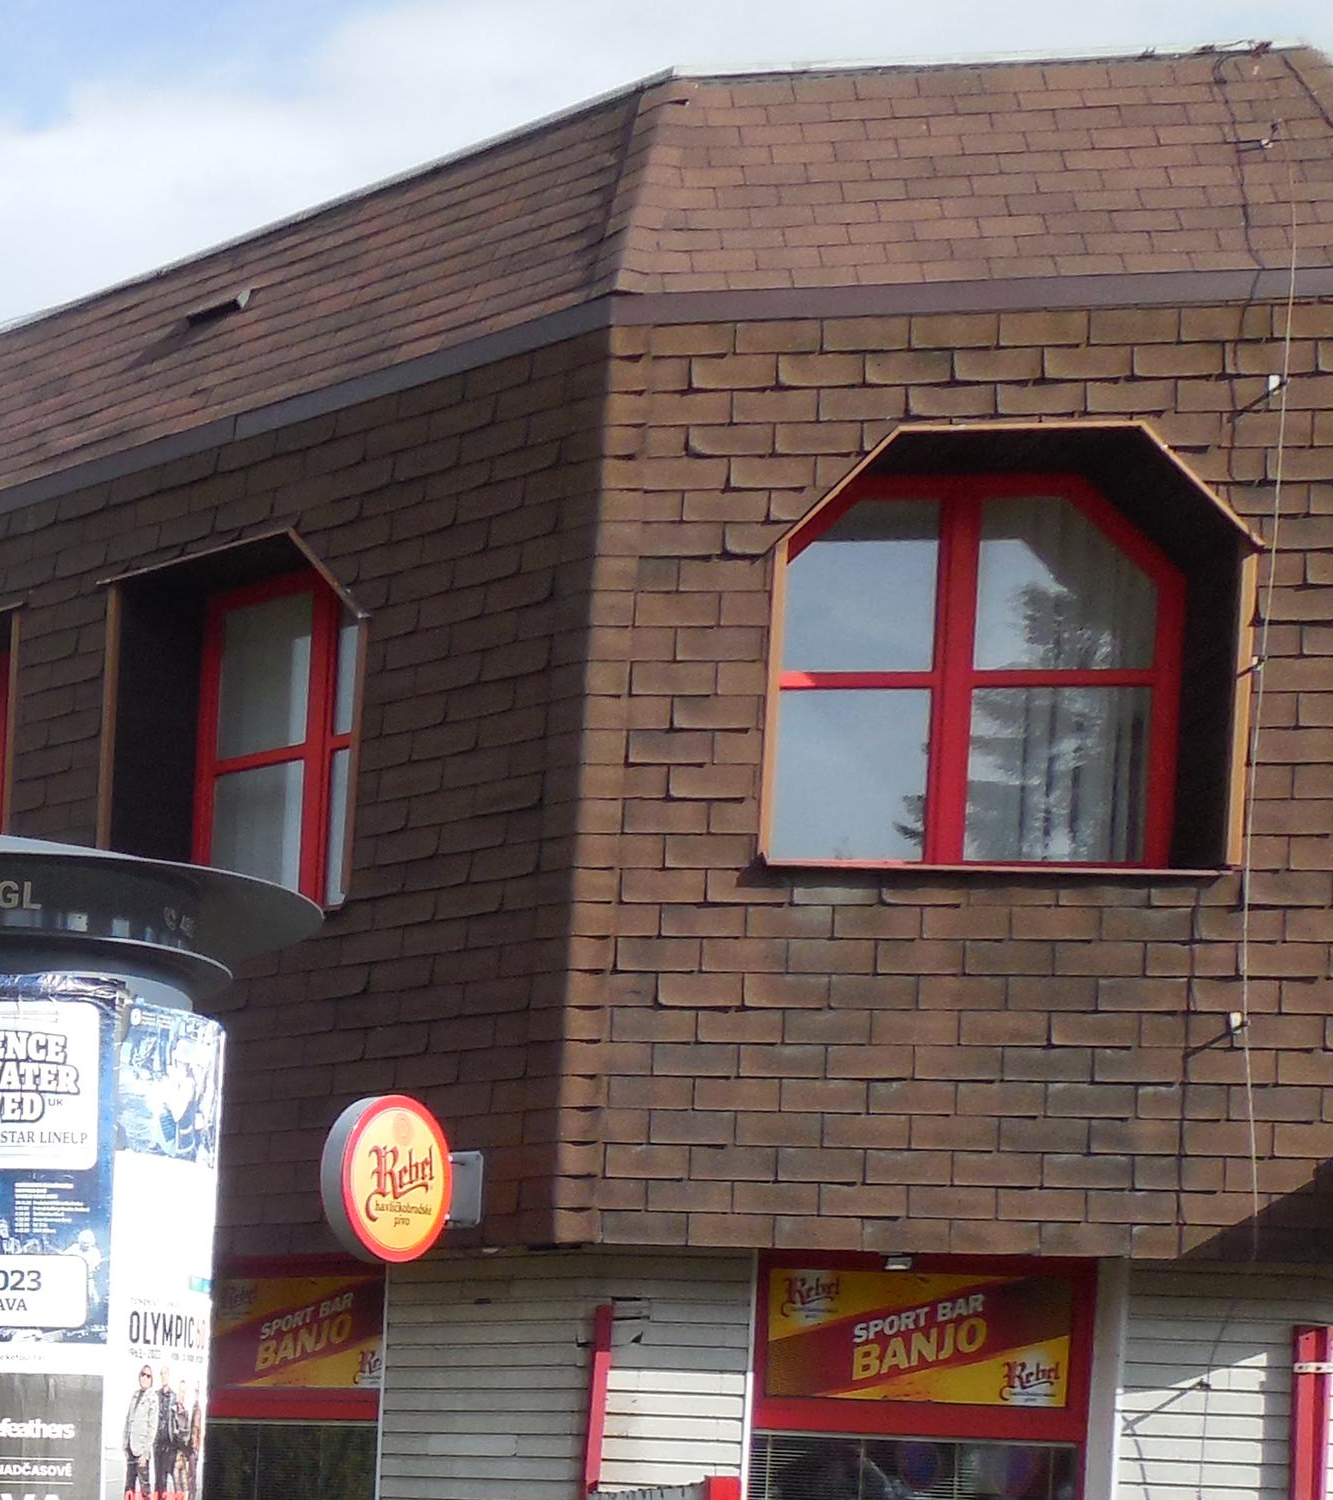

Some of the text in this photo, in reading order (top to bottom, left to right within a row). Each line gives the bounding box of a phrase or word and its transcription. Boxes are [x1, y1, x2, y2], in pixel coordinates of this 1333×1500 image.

[48, 1098, 64, 1107] UK
[0, 1131, 36, 1143] STAR
[39, 1131, 88, 1145] LINEUP
[366, 1145, 435, 1203] Rebel
[782, 1276, 840, 1309] Rebel
[129, 1311, 195, 1350] OLYMPIC
[260, 1292, 354, 1340] SPORT BAR
[852, 1293, 984, 1343] SPORT BAR
[254, 1312, 353, 1372] BANJO
[851, 1316, 988, 1381] BANJO
[1000, 1360, 1061, 1394] Rebel
